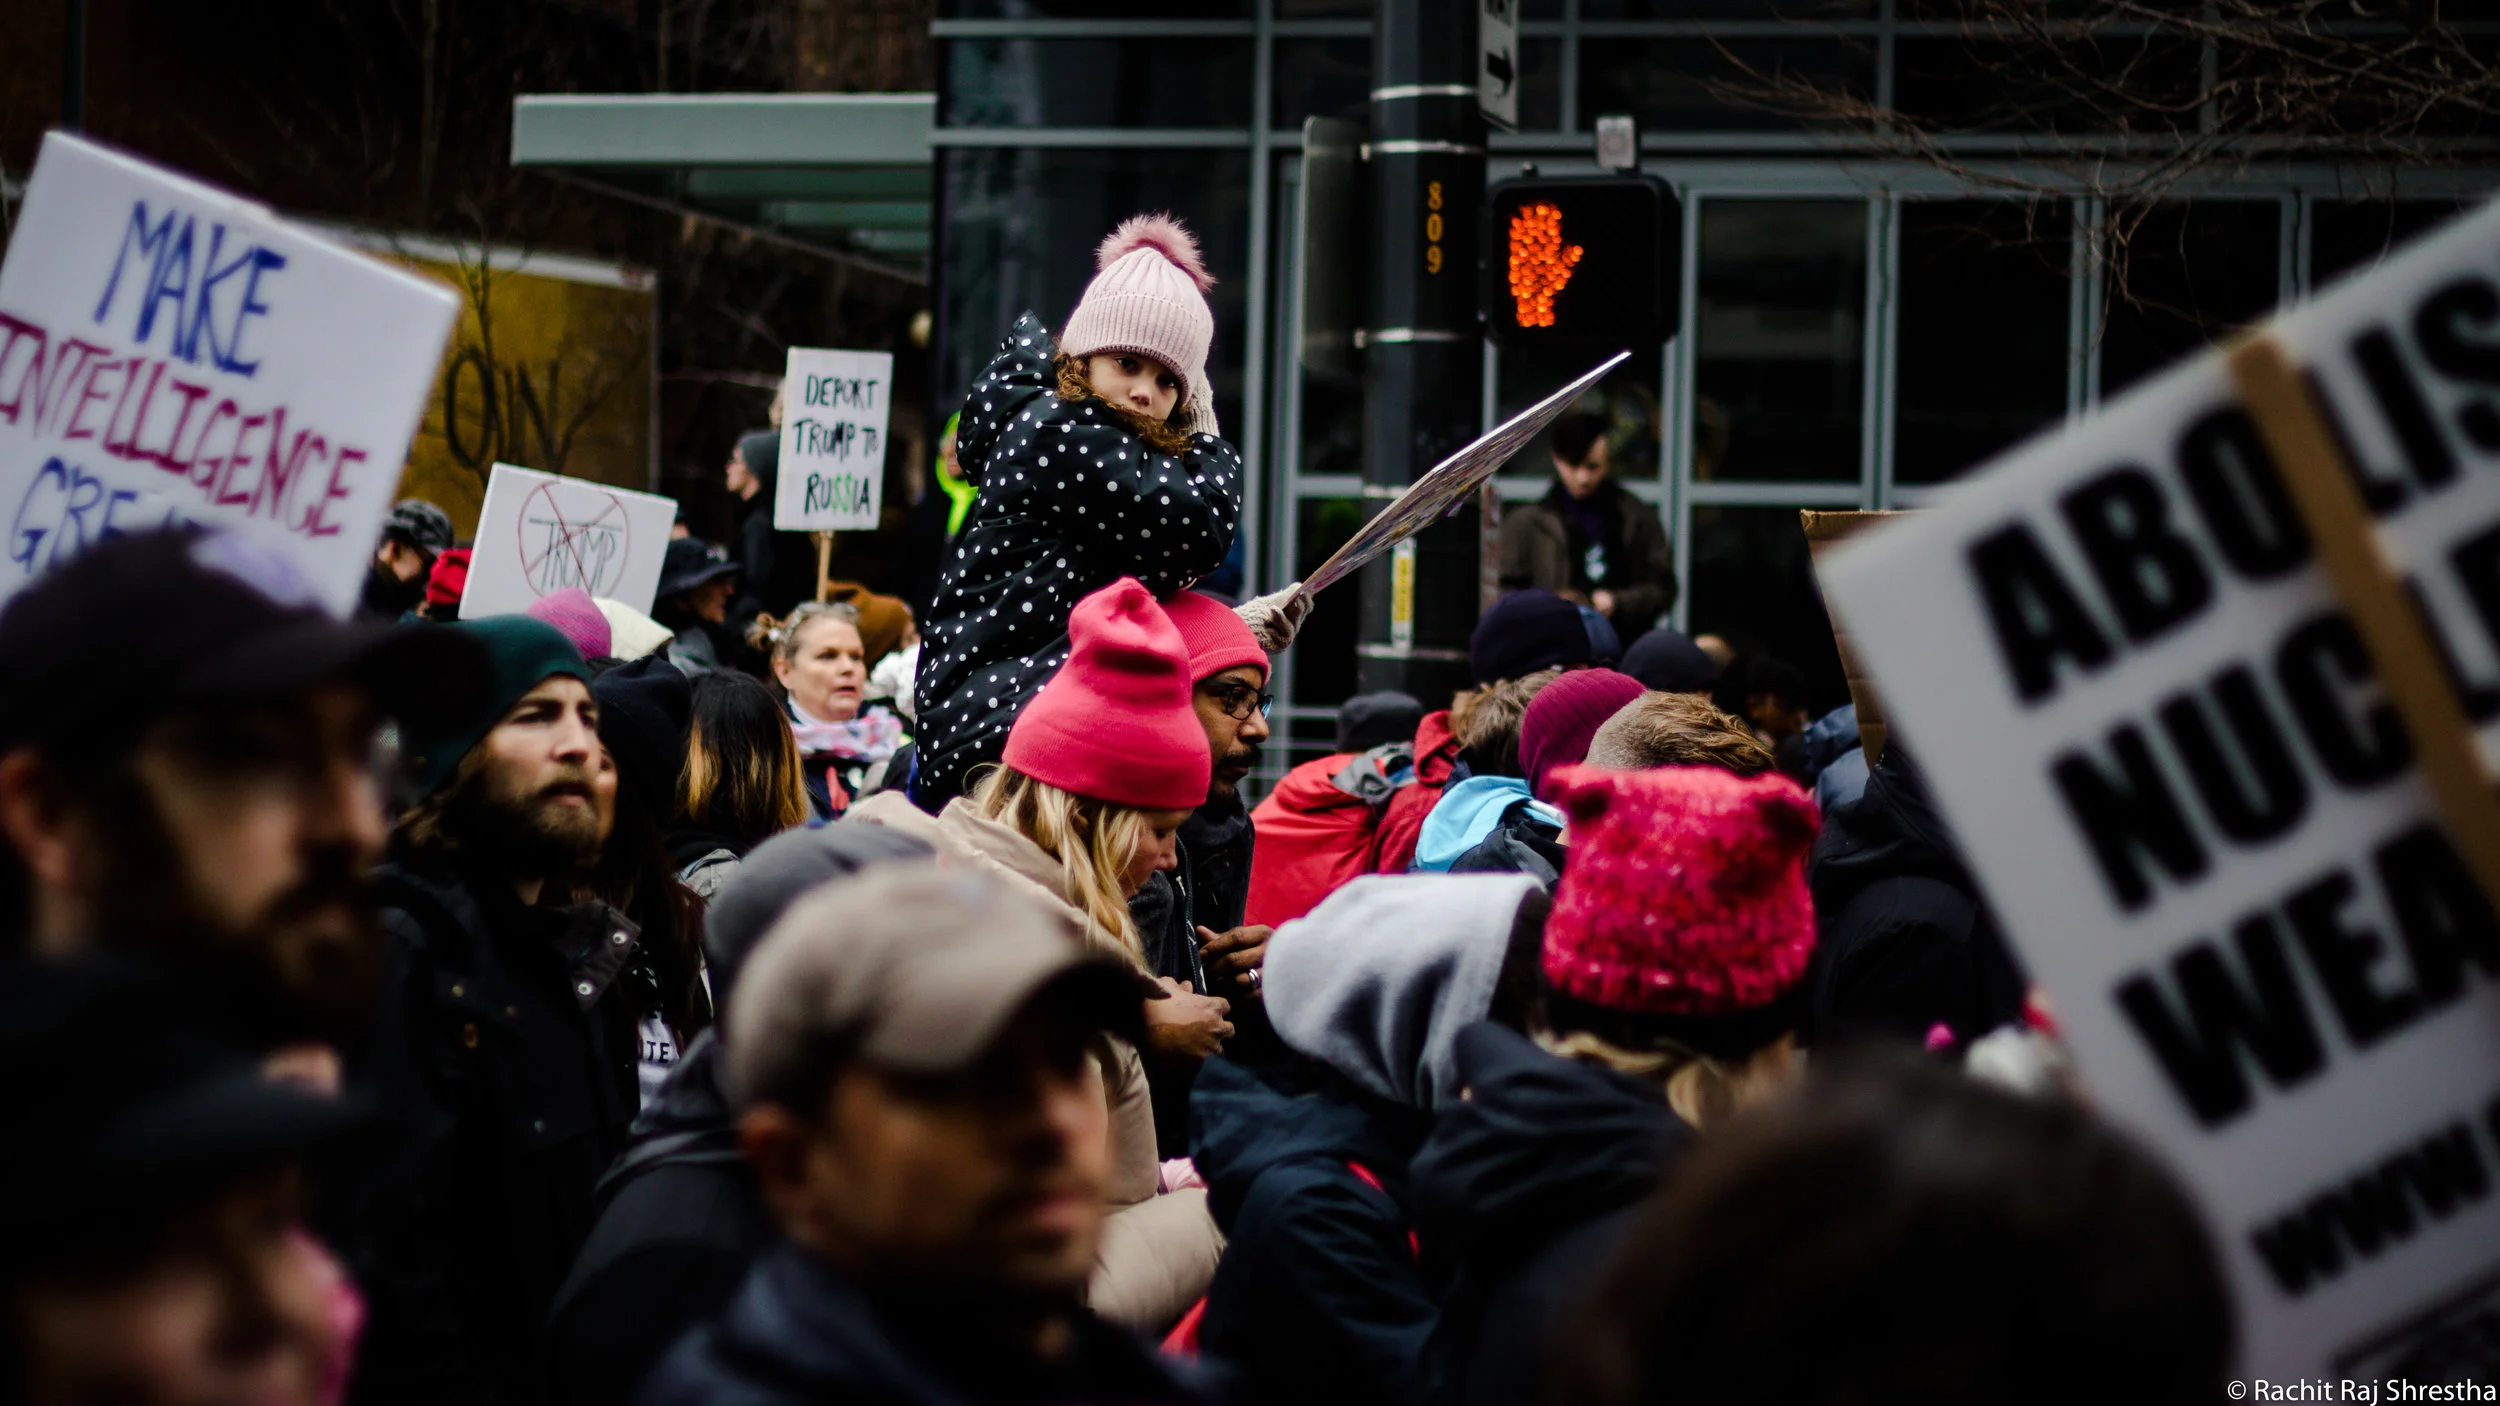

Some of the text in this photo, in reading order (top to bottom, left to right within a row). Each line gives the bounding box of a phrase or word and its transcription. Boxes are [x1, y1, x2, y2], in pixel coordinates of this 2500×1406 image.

[94, 200, 287, 378] MAKE
[0, 312, 366, 539] INTELLIGENCE
[793, 418, 855, 462] TRUMP
[805, 374, 879, 410] DEPORT
